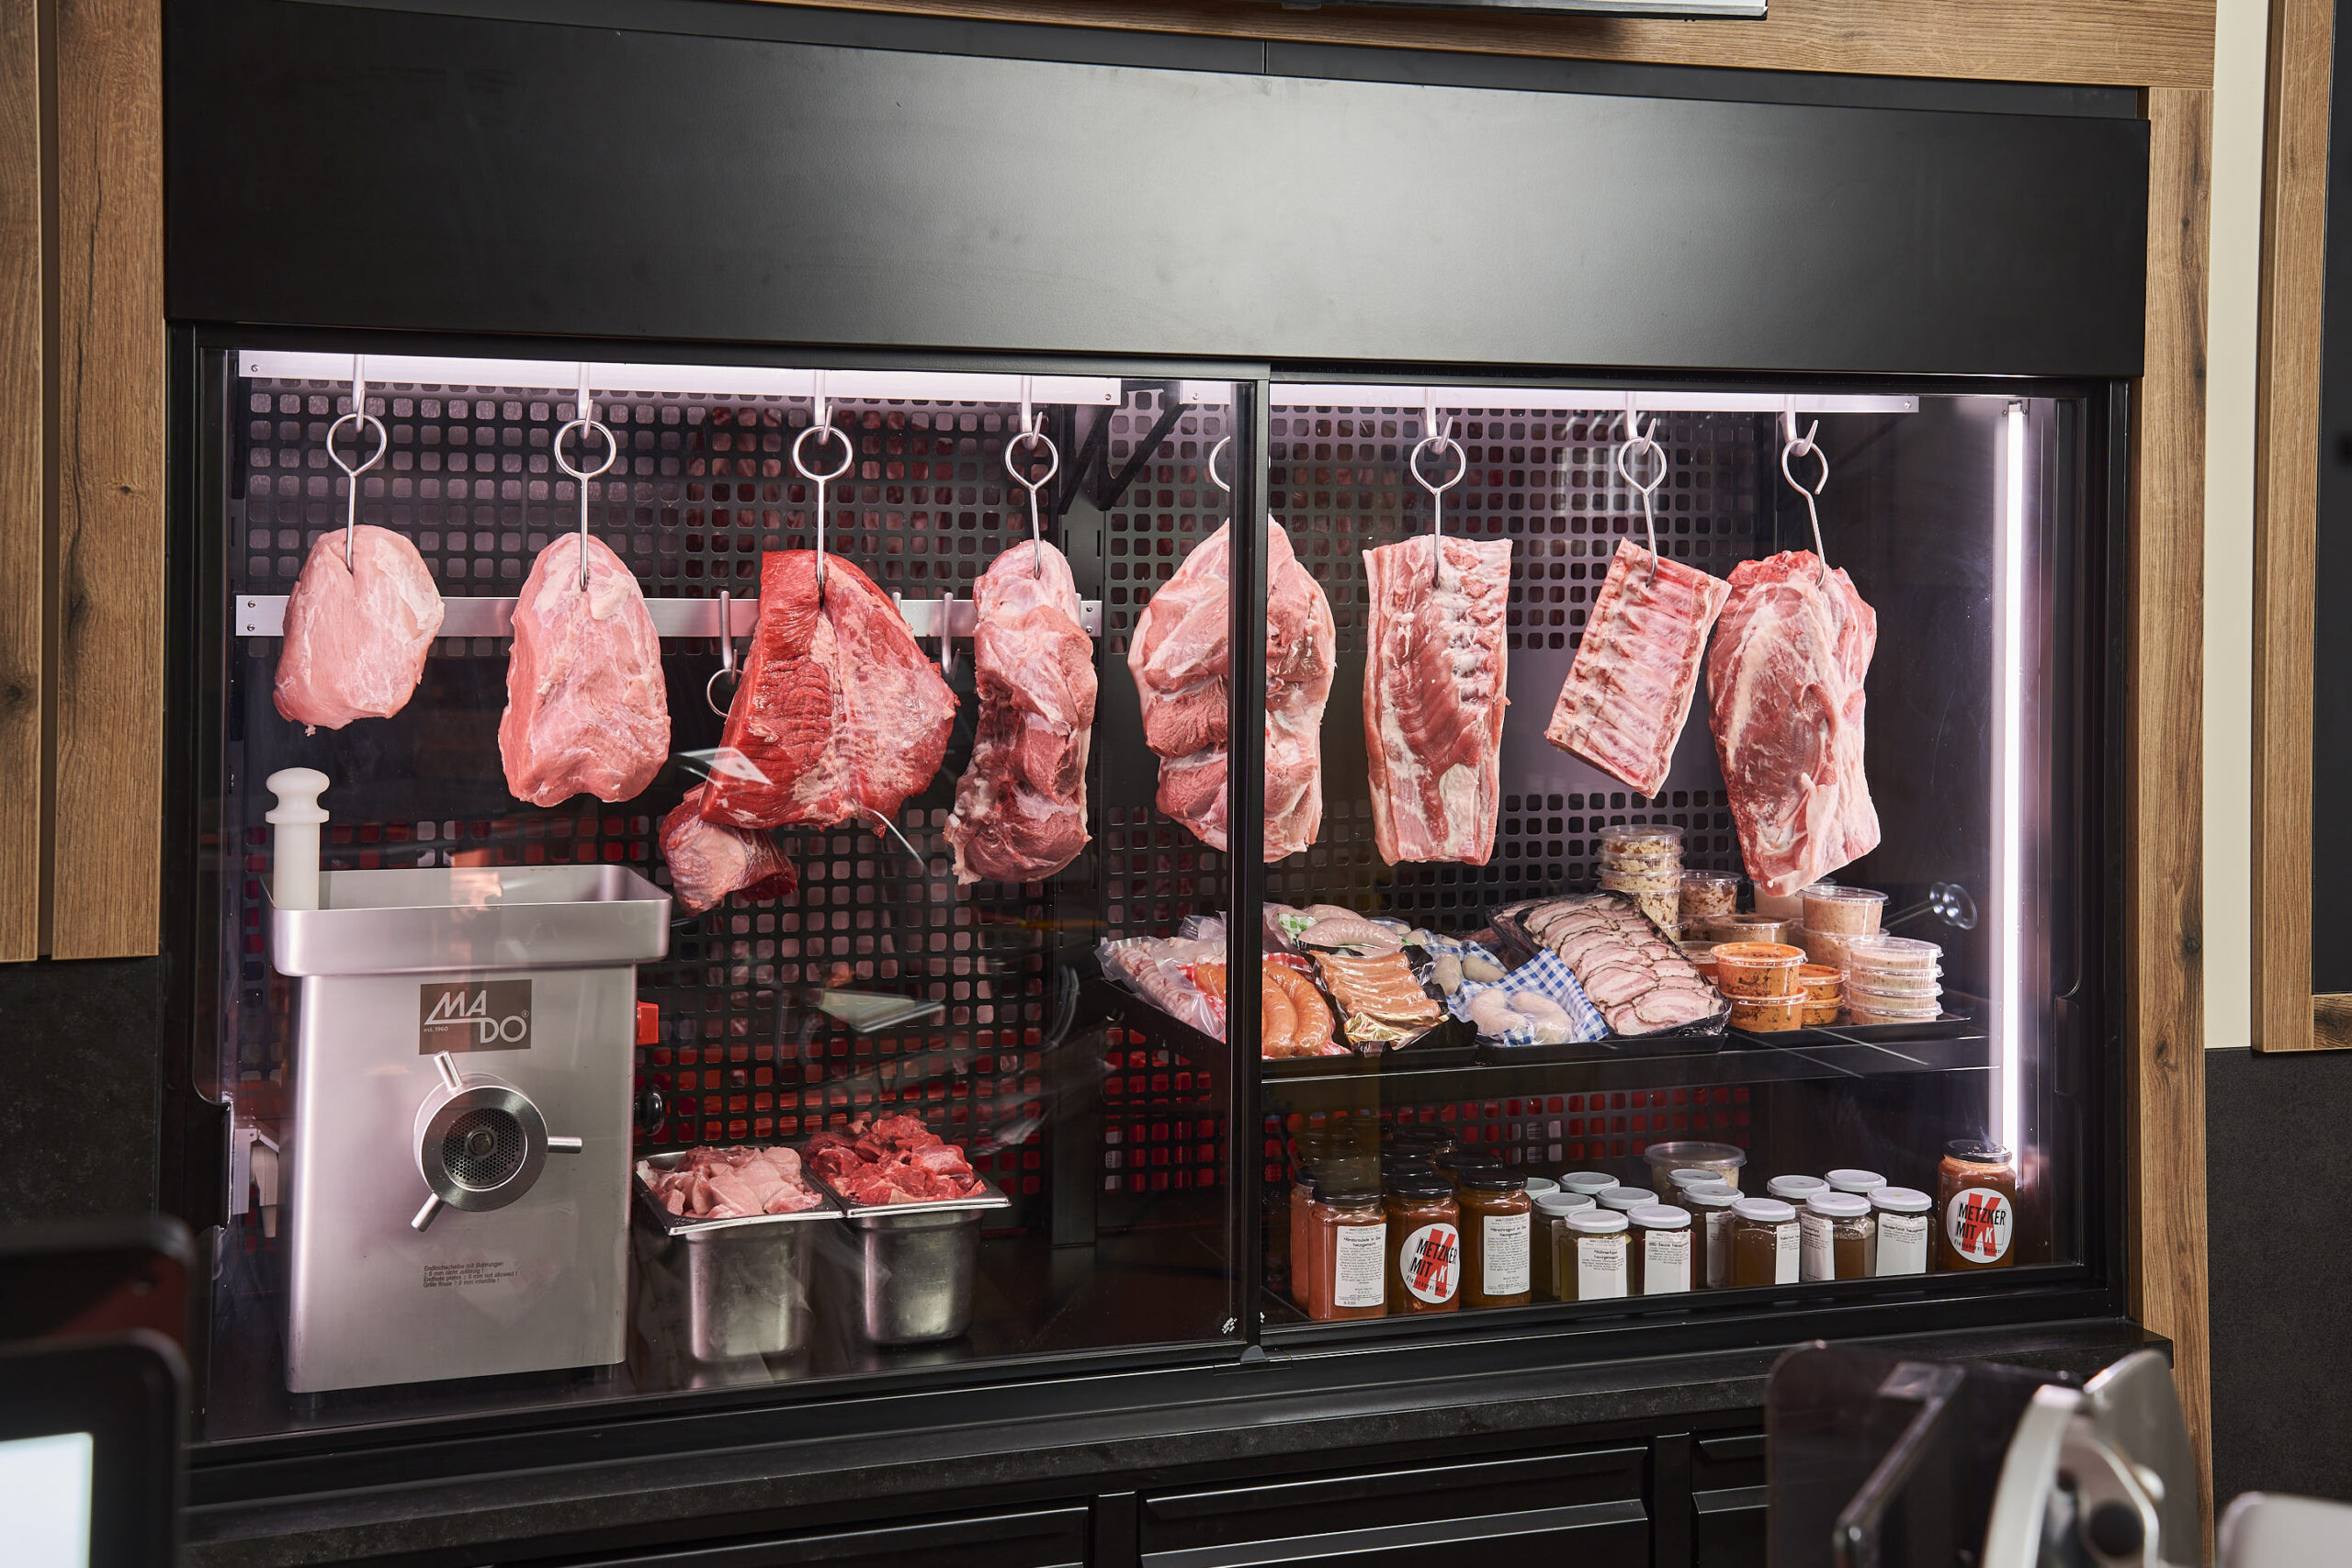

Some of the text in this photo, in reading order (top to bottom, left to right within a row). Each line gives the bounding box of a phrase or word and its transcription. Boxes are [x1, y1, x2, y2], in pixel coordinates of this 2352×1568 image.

[1959, 1203, 2006, 1225] METZKER
[1957, 1222, 1994, 1243] MIT K
[1417, 1239, 1457, 1265] METZKER
[1411, 1257, 1447, 1282] MIT K
